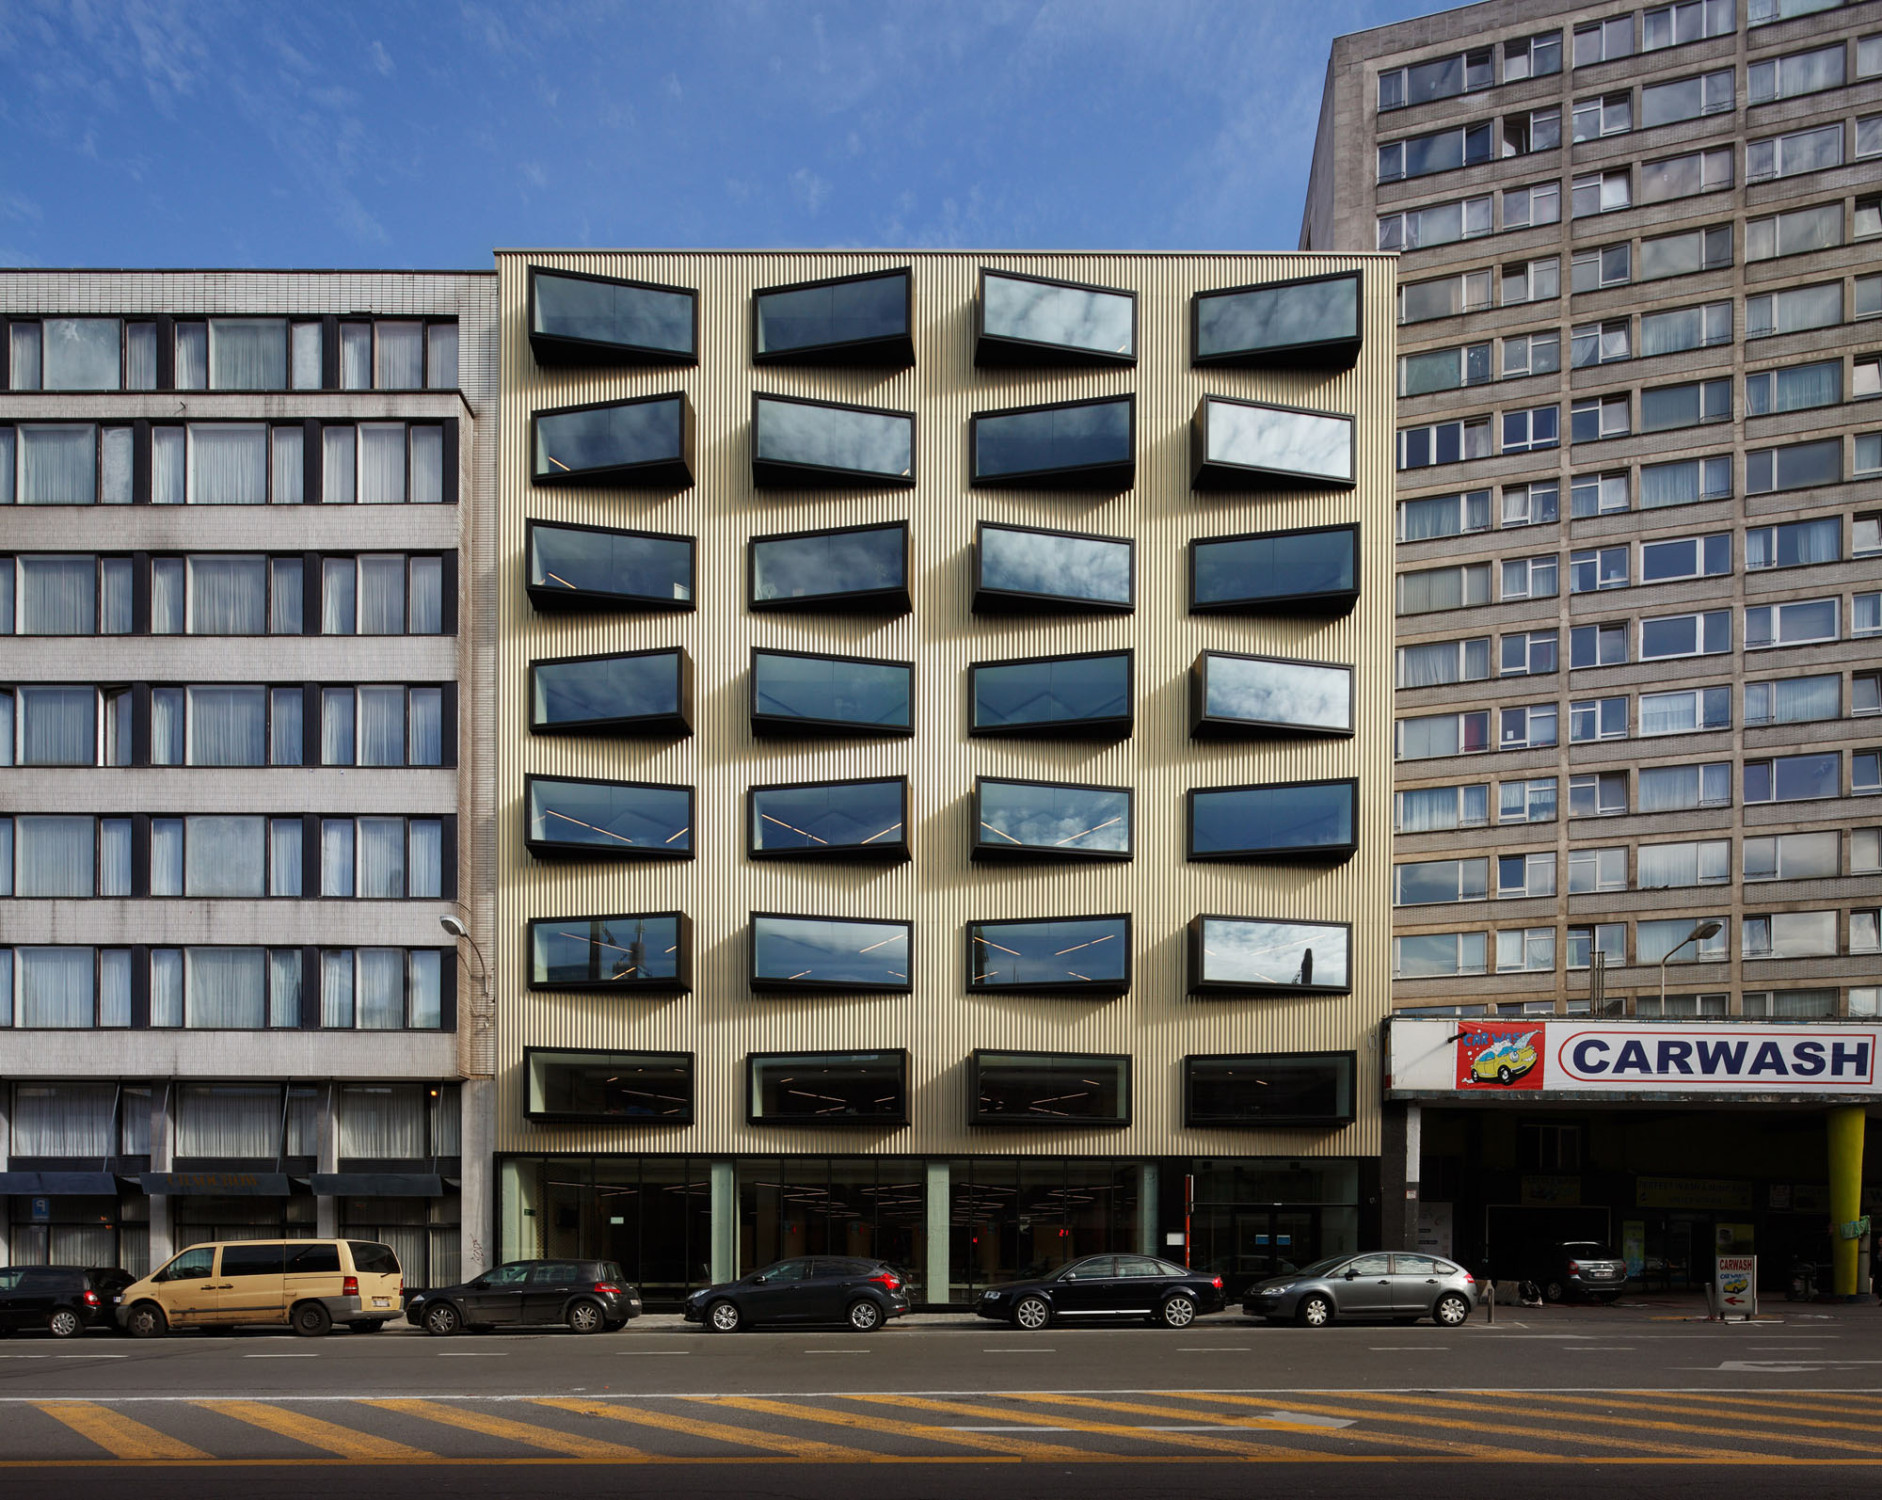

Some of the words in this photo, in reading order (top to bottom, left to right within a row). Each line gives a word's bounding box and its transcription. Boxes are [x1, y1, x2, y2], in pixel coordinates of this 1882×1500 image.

[1463, 1032, 1489, 1047] CAR
[1491, 1031, 1525, 1044] WAS
[1572, 1039, 1870, 1076] CARWASH
[1719, 1258, 1752, 1271] CARWASH
